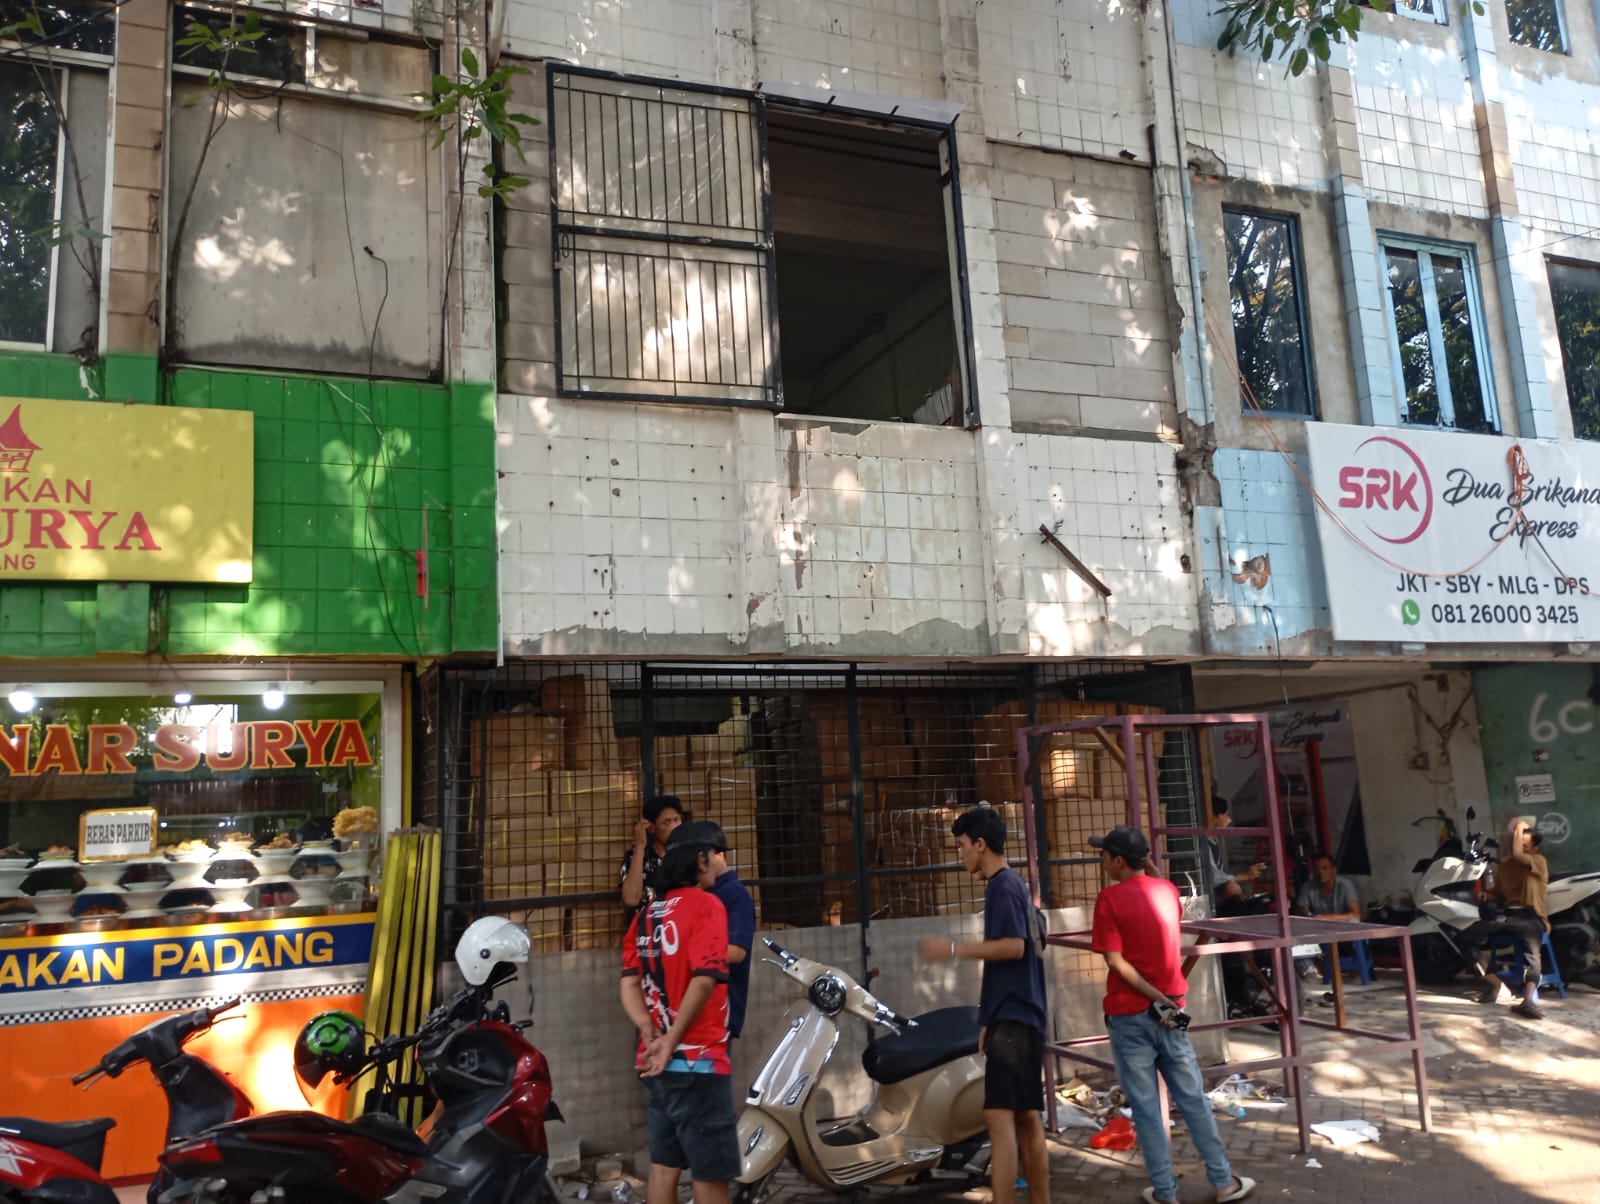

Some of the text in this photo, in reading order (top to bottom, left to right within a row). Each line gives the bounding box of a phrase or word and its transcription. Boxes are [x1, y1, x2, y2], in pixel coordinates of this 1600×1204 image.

[4, 476, 92, 505] KAN
[1339, 466, 1420, 511] SRK
[1443, 468, 1505, 508] Dua
[1489, 507, 1579, 549] Express
[0, 553, 36, 571] NG
[1396, 573, 1429, 593] JKT
[1446, 575, 1481, 594] SBY
[1499, 576, 1539, 595] MLG
[1555, 577, 1590, 596] DPS
[1431, 604, 1579, 624] 081 26000 3425
[152, 719, 374, 772] SURYA
[1223, 728, 1254, 748] SRK
[86, 822, 151, 845] BEBAS PARKIR
[1537, 821, 1567, 835] SRK
[0, 931, 334, 988] AKAN PADANG
